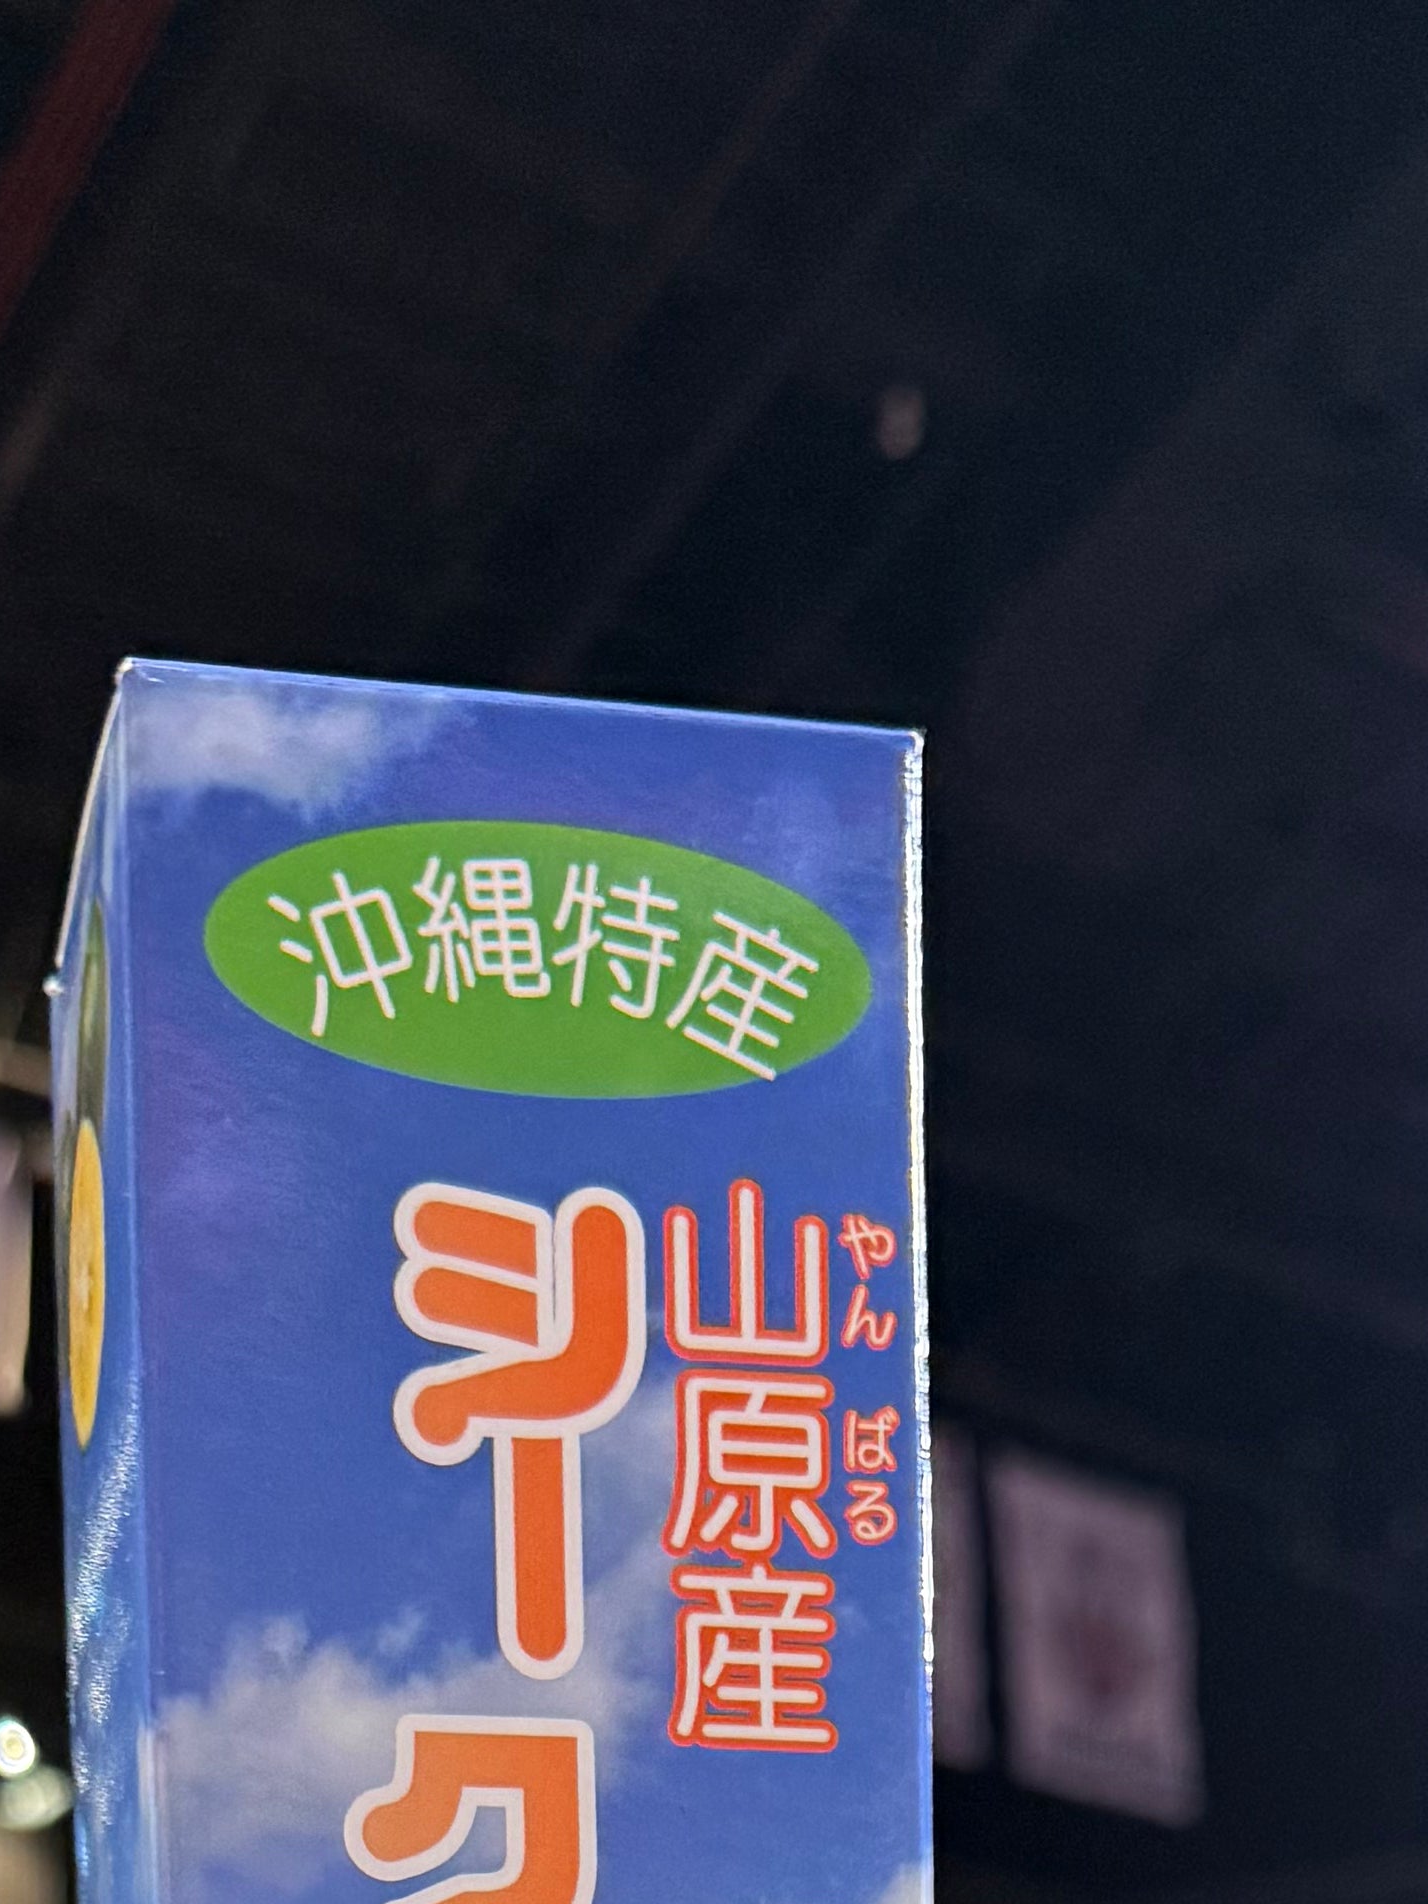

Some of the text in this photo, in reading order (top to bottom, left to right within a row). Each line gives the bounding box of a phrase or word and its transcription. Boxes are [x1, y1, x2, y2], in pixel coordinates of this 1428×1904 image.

[267, 856, 820, 1081] 沖縄特産
[662, 1178, 838, 1752] 山原産
